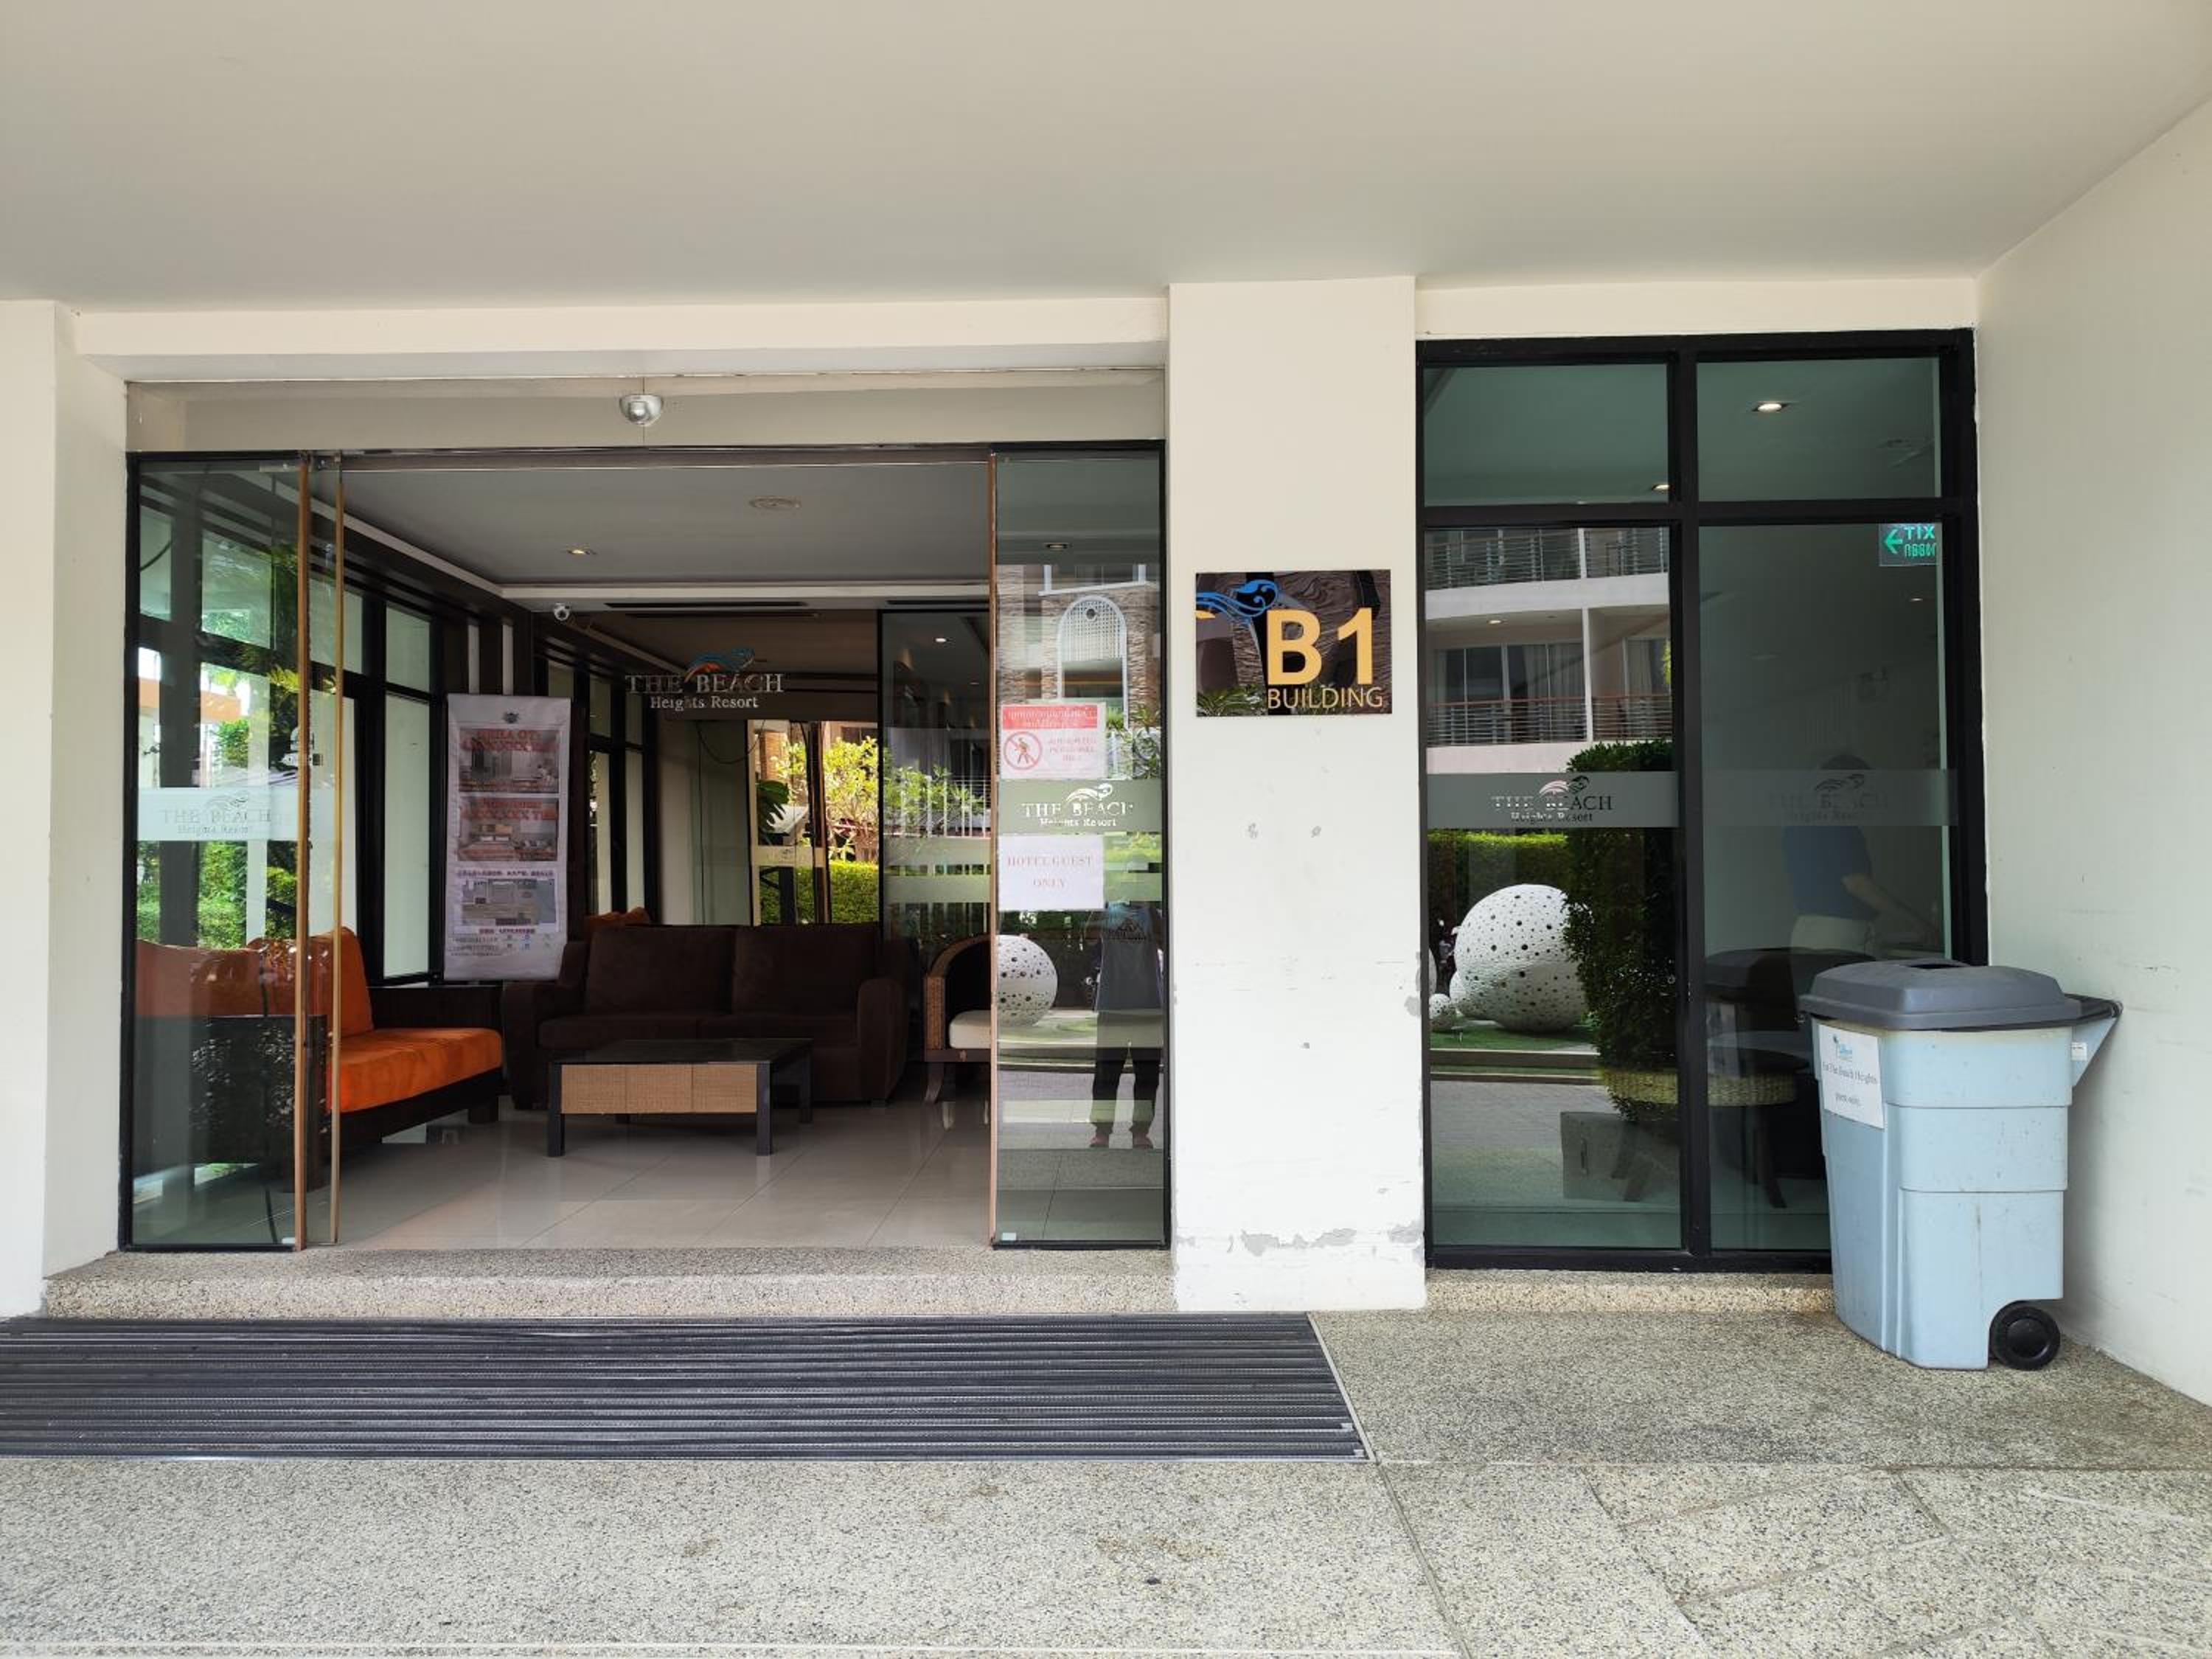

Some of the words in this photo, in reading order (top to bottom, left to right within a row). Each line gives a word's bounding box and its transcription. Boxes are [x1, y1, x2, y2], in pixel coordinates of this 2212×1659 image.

[625, 673, 684, 693] THE
[695, 672, 785, 693] BEACH
[650, 696, 705, 712] Heights
[711, 695, 759, 709] Resort
[1267, 687, 1383, 709] BUILDING
[1020, 802, 1062, 817] THE
[1072, 801, 1134, 816] BEACH
[1490, 795, 1534, 810] THE
[1545, 795, 1613, 810] BEACH
[1083, 818, 1117, 827] Resort
[1557, 812, 1593, 822] Resort
[1007, 855, 1049, 866] HOTEL
[1051, 855, 1092, 866] GUEST
